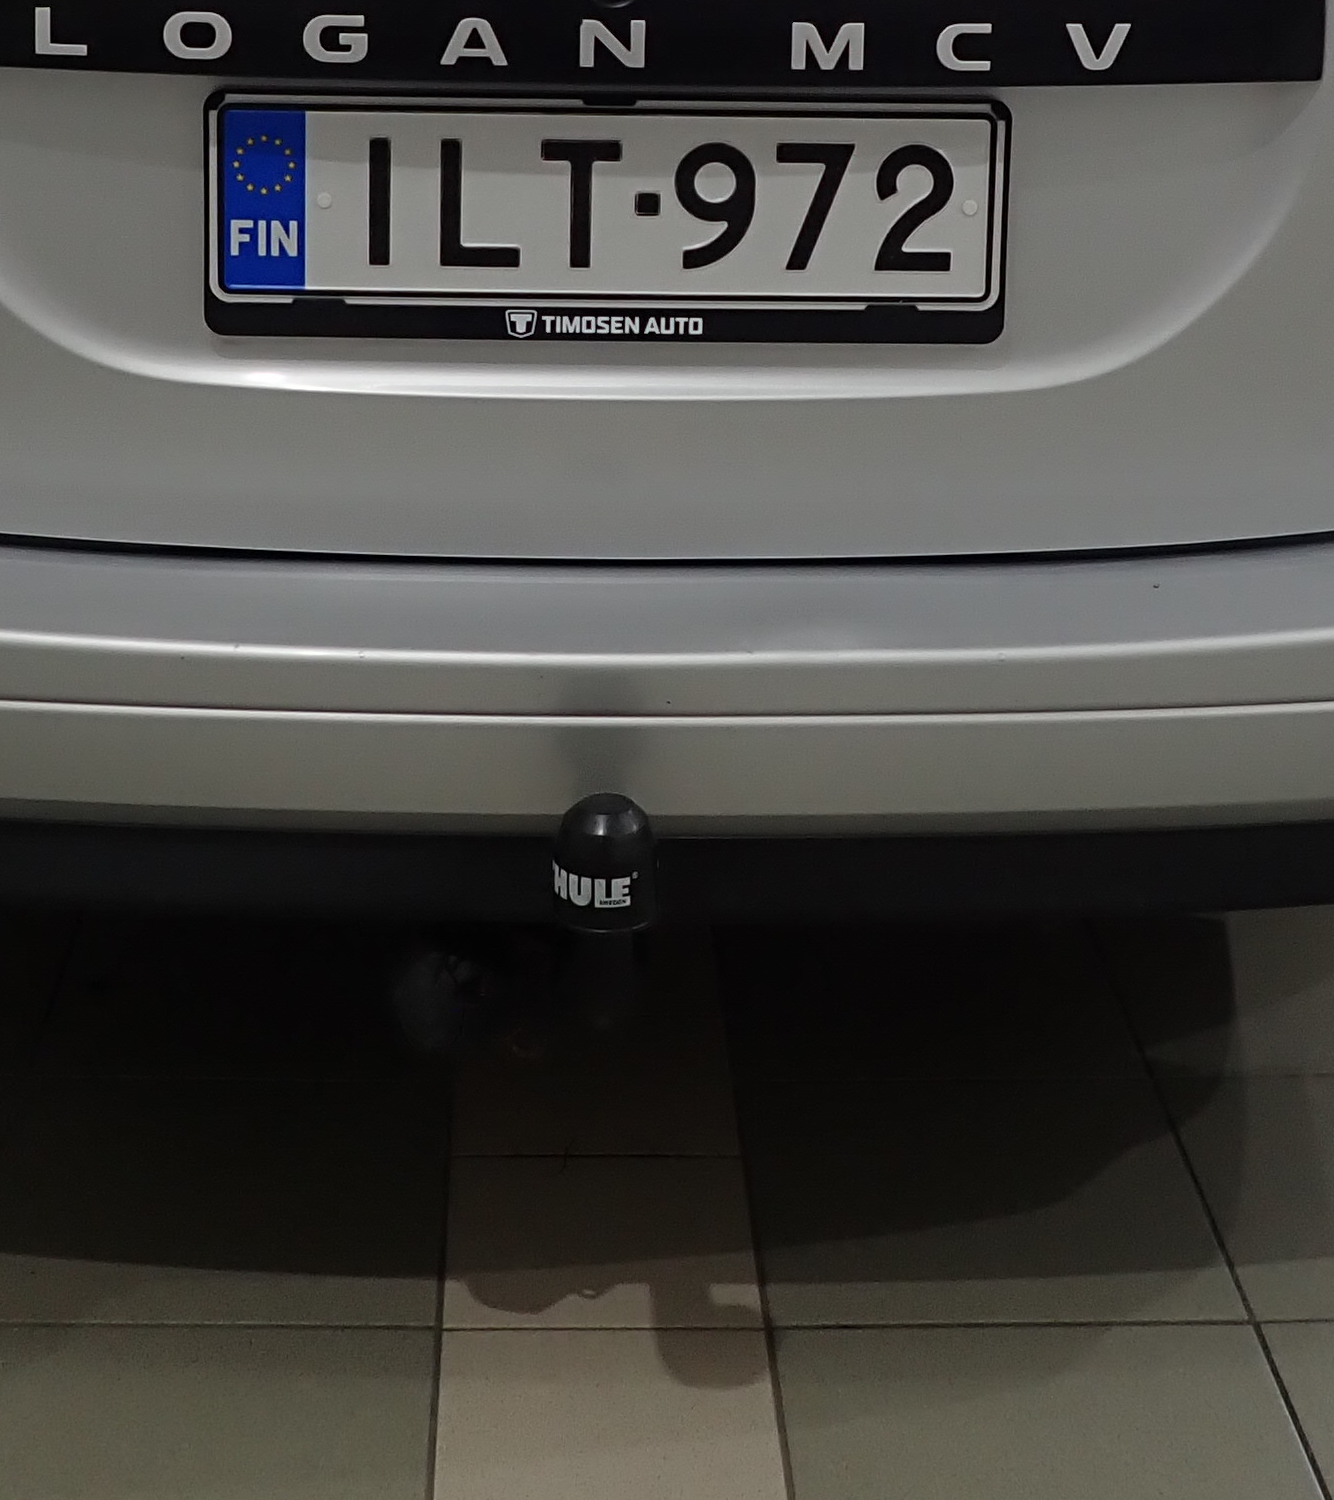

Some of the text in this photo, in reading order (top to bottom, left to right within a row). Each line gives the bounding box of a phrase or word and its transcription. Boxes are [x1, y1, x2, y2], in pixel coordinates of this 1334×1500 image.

[34, 6, 1132, 72] LOGAN MCV
[229, 219, 299, 257] FIN
[541, 315, 640, 334] TIMOSEN
[644, 316, 703, 335] AUTO
[552, 860, 632, 908] HULE
